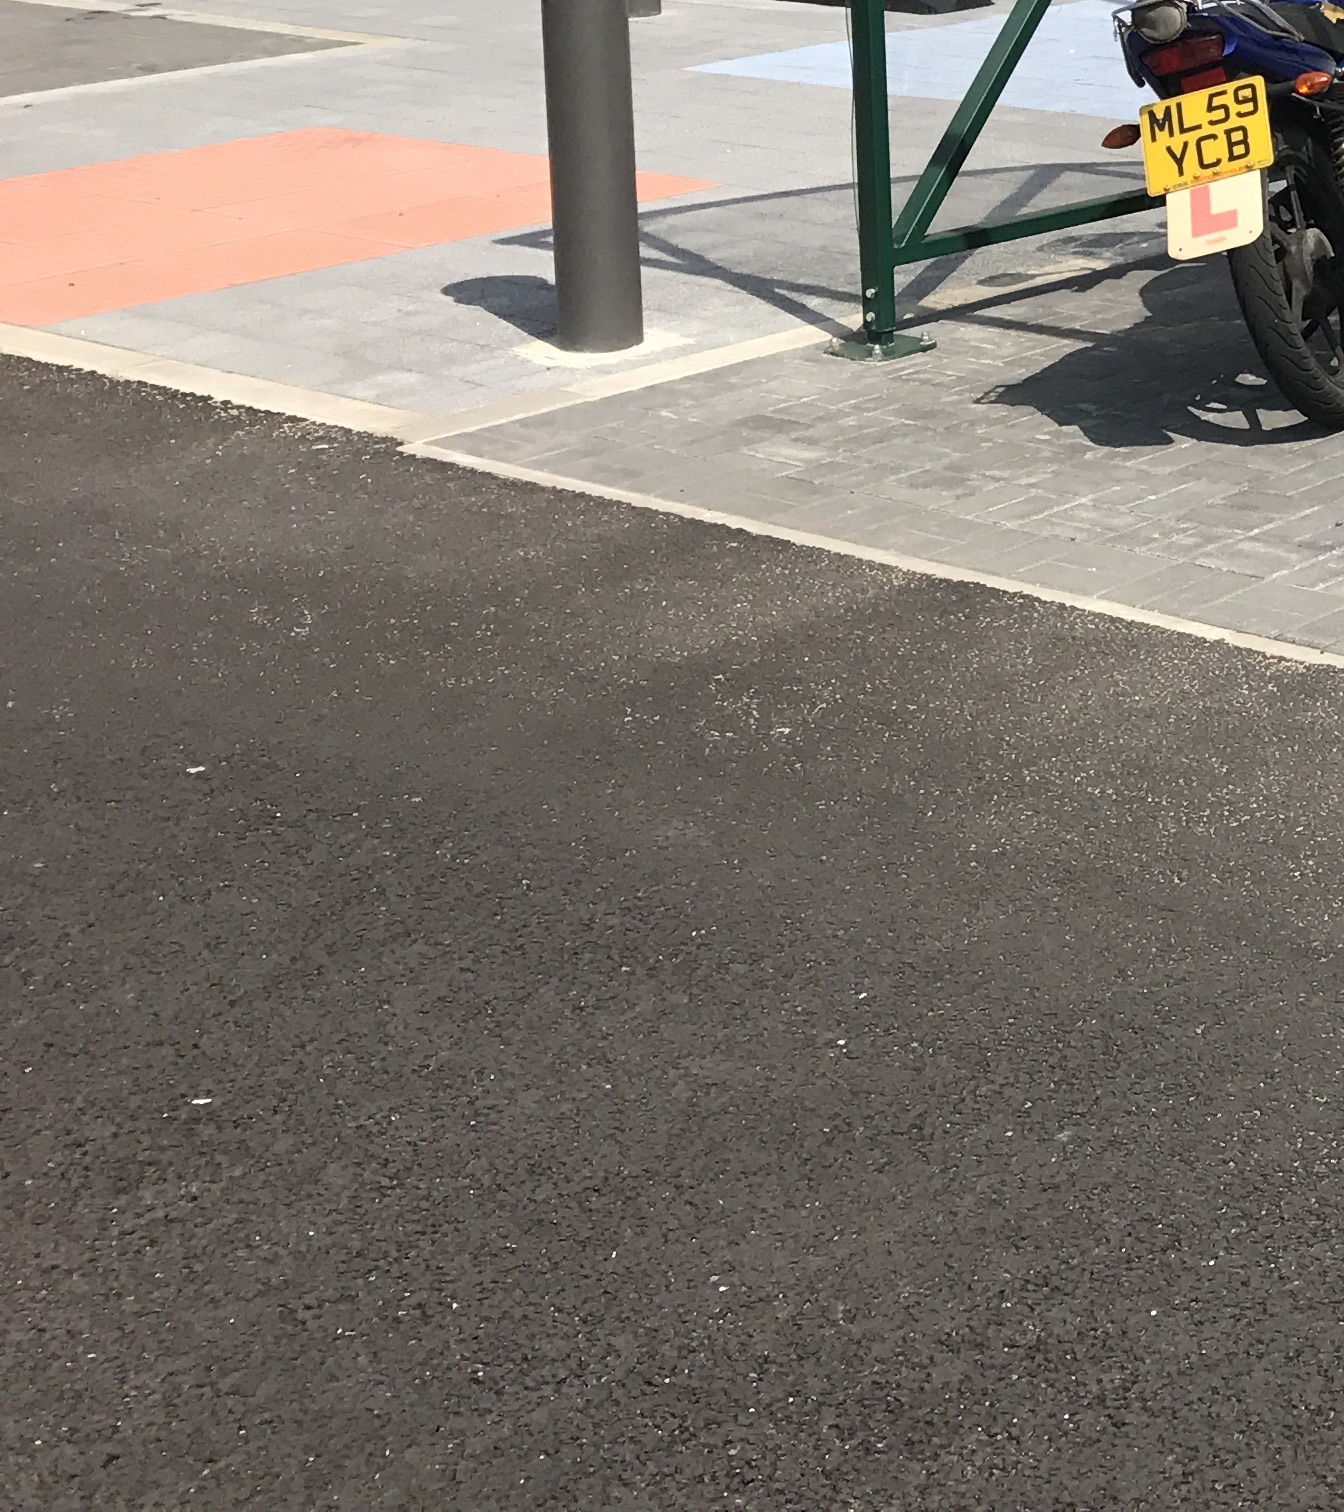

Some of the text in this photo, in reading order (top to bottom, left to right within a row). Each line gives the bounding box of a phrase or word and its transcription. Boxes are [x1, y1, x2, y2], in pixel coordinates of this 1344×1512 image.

[1147, 83, 1259, 143] ML59
[1166, 125, 1251, 178] YCB
[1190, 184, 1239, 239] L
